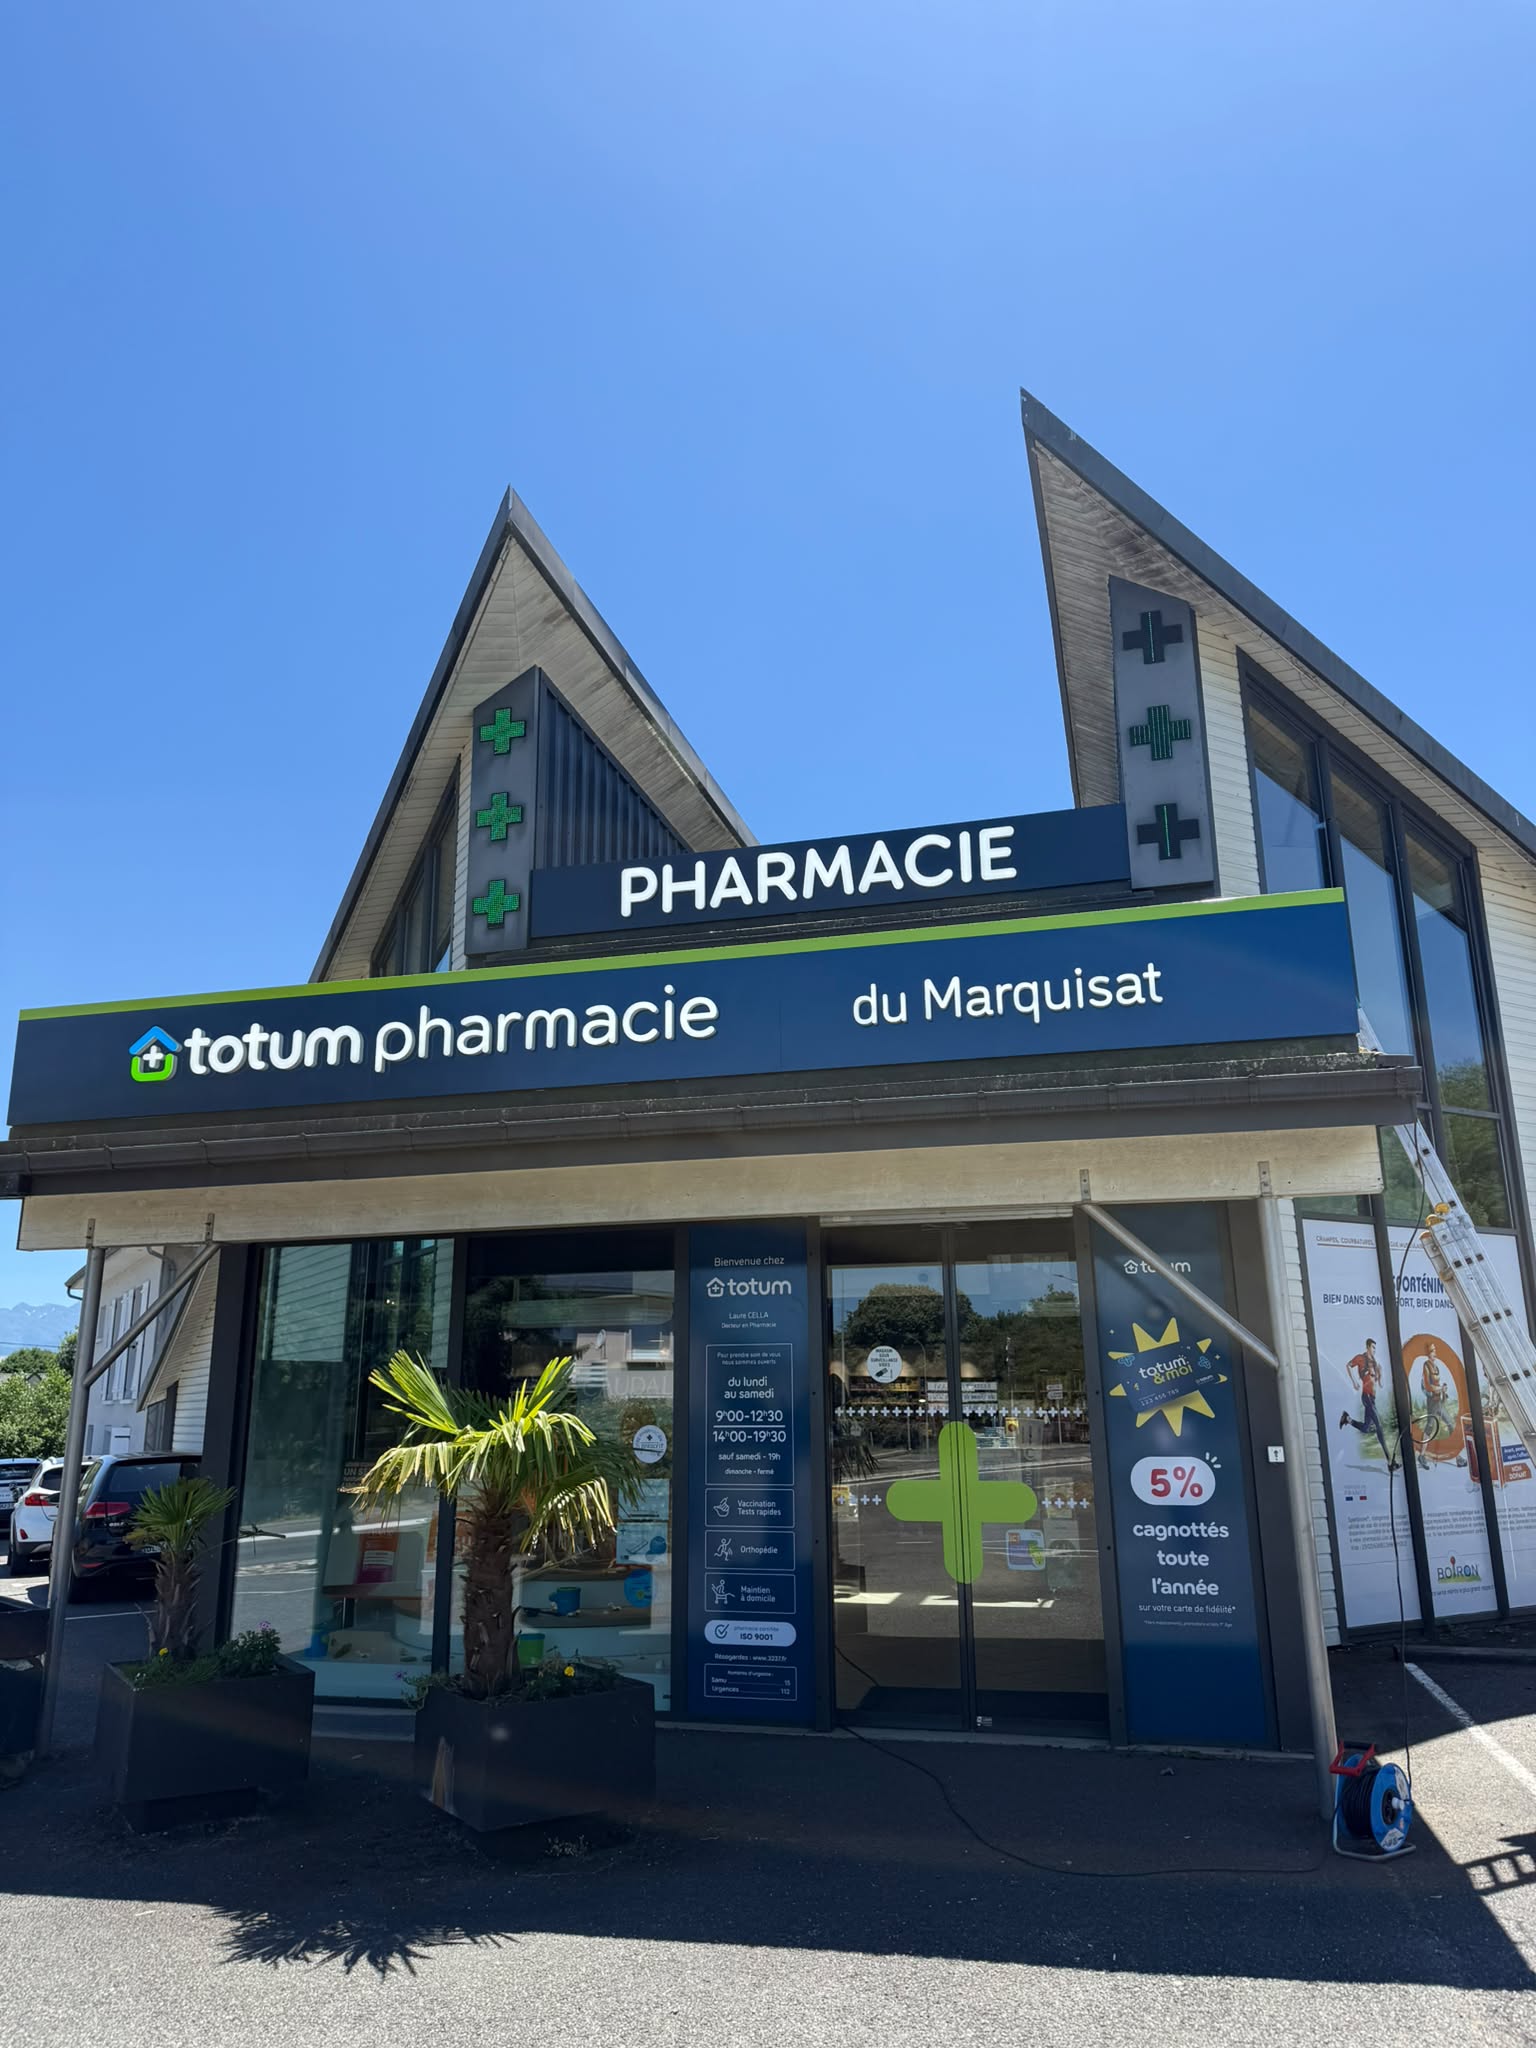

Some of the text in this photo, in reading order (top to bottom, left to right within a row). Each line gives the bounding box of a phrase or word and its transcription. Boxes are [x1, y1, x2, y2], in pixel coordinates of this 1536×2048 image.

[620, 825, 1018, 918] PHARMACIE
[852, 962, 1164, 1026] du Marquisat
[183, 983, 720, 1075] totum pharmacie
[714, 1256, 785, 1267] Bienvenue chez
[727, 1278, 792, 1295] totum
[1323, 1293, 1341, 1304] BIEN
[1343, 1294, 1364, 1305] DANS
[1417, 1298, 1433, 1308] BIEN
[729, 1311, 769, 1320] Laure CELLA
[1138, 1356, 1187, 1379] totum
[728, 1376, 768, 1387] du lundi
[724, 1388, 774, 1399] au samedi
[715, 1409, 784, 1422] 9h00-12h30
[712, 1430, 787, 1442] 14h00-19h30
[718, 1452, 734, 1461] sauf
[735, 1452, 761, 1461] samedi
[768, 1453, 781, 1461] 19h
[1150, 1465, 1204, 1498] 5%
[737, 1499, 776, 1508] Vaccination
[738, 1507, 781, 1517] Tests rapides
[1132, 1521, 1230, 1542] cagnottés
[740, 1545, 778, 1555] Orthopédie
[1156, 1550, 1210, 1567] toute
[1437, 1558, 1480, 1581] BOIRON
[740, 1585, 770, 1594] Maintien
[1151, 1577, 1219, 1596] l'année
[740, 1594, 776, 1603] à domicile
[1152, 1604, 1172, 1612] votre
[1173, 1605, 1193, 1613] carte
[1194, 1604, 1204, 1613] de
[754, 1633, 773, 1641] 9001
[711, 1676, 727, 1684] Samu
[711, 1685, 739, 1693] Urgences
